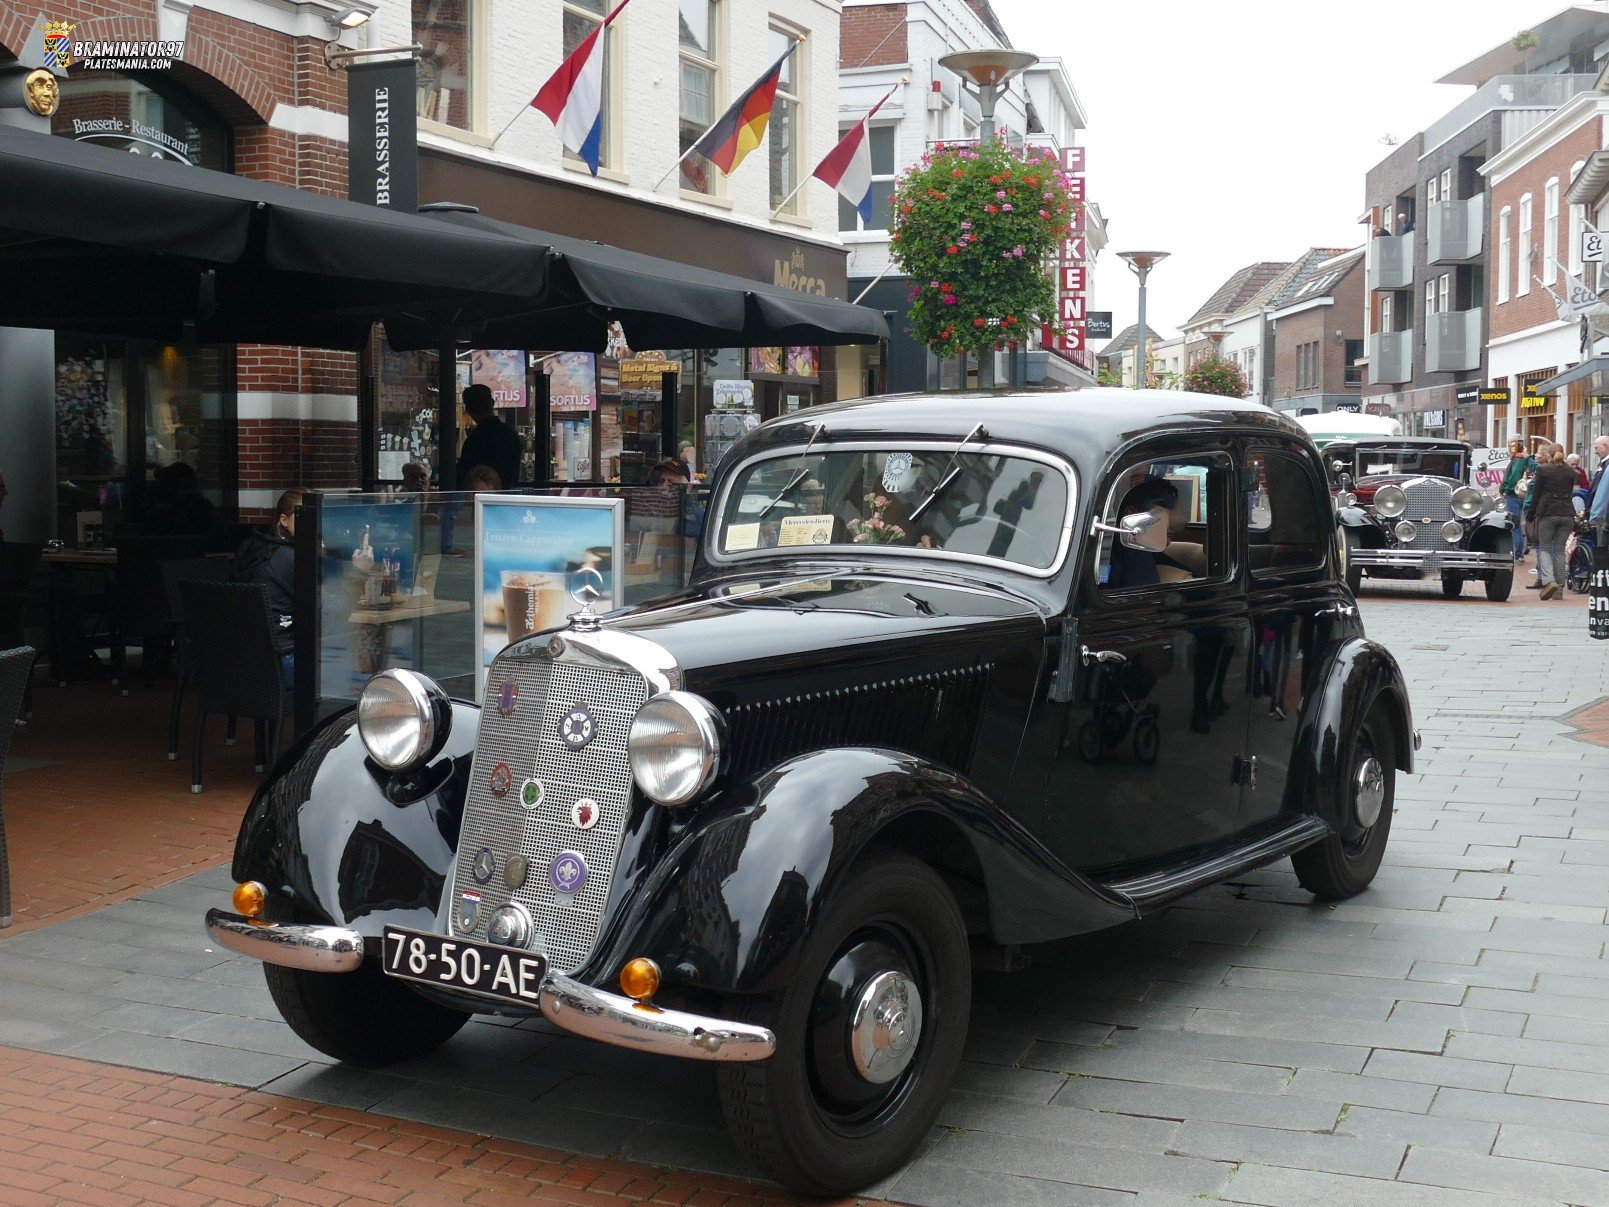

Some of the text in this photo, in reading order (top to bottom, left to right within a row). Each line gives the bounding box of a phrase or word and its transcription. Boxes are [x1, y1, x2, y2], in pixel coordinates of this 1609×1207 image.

[72, 117, 124, 135] Brasserie
[130, 119, 190, 156] Restaurant
[375, 87, 390, 206] BRASSERIE
[622, 363, 647, 373] Metal
[646, 363, 670, 374] Signs
[1480, 392, 1508, 400] xenos
[485, 531, 517, 543] Frozen
[387, 932, 539, 999] 78-50-AE
